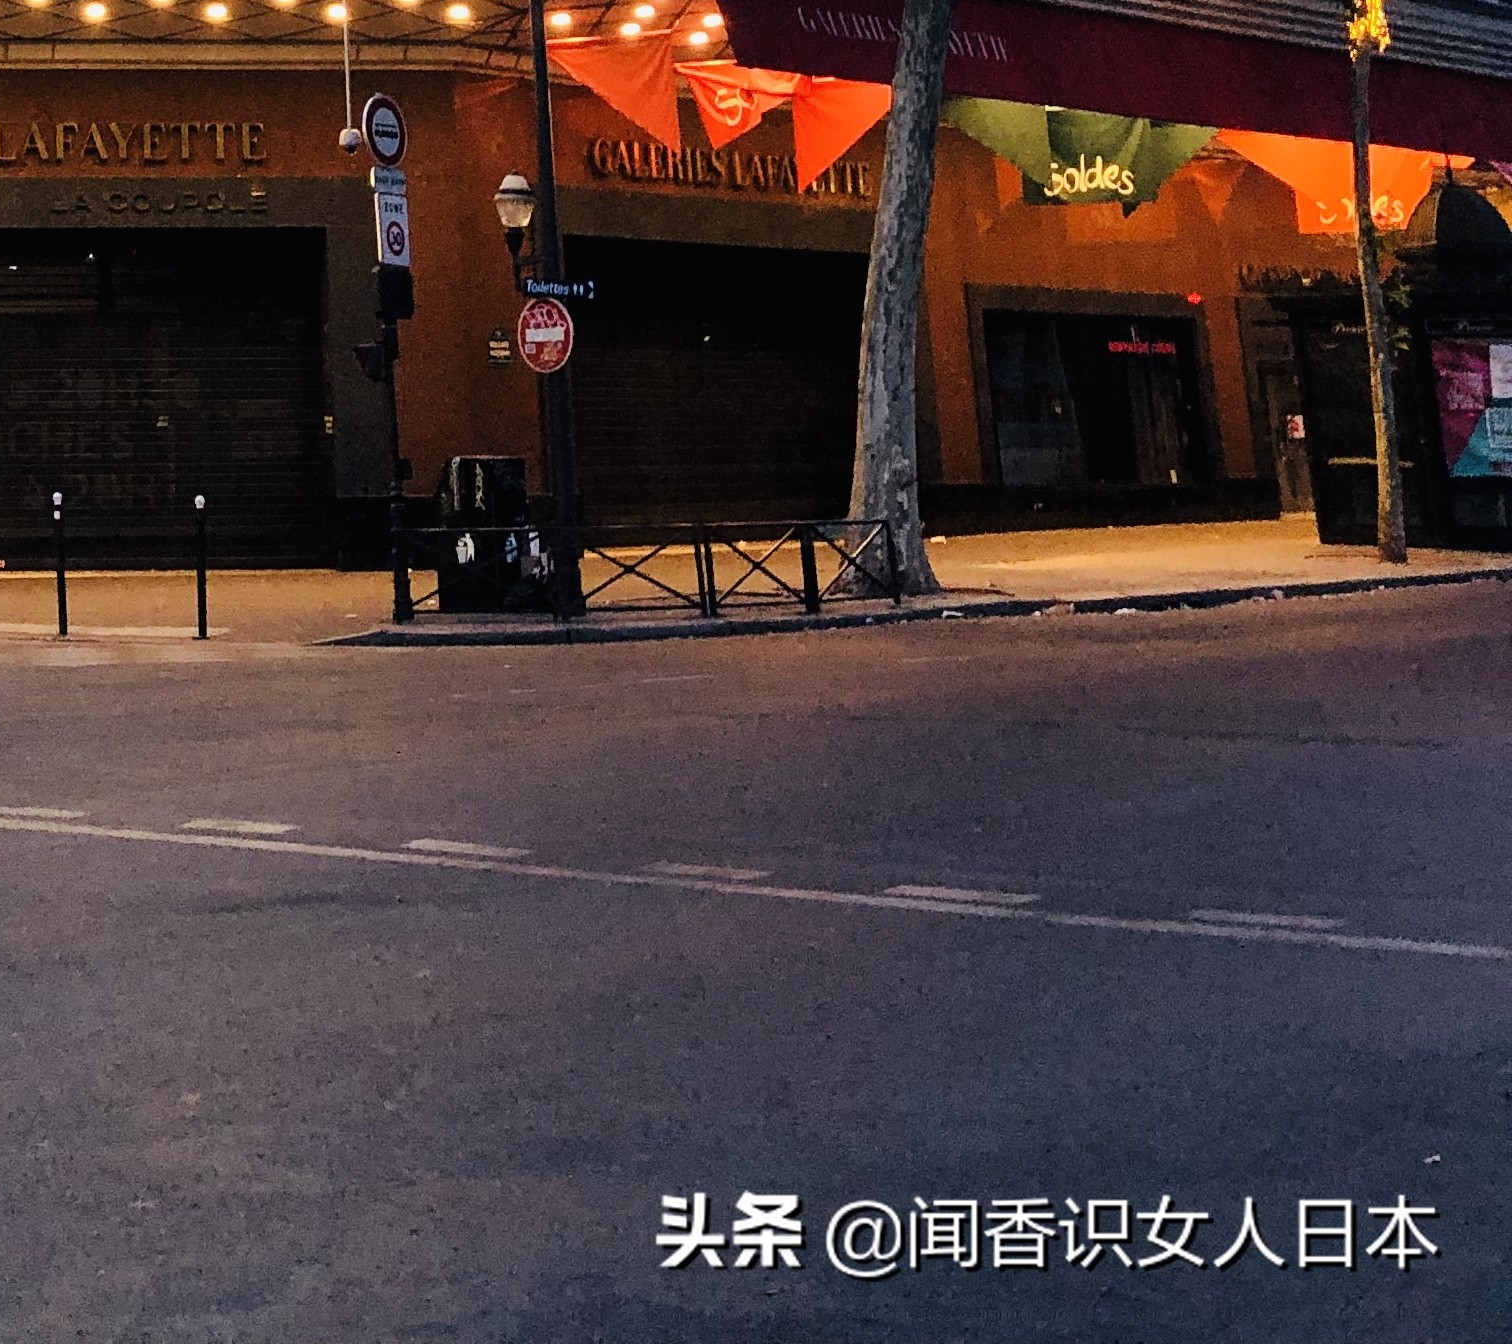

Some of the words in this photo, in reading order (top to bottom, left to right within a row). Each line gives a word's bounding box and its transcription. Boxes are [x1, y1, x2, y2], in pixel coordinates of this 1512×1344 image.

[594, 136, 726, 183] GALERIES
[734, 149, 873, 197] LAFATTE
[384, 202, 404, 214] ZONE
[391, 229, 403, 246] 30
[526, 279, 569, 295] Toilettes
